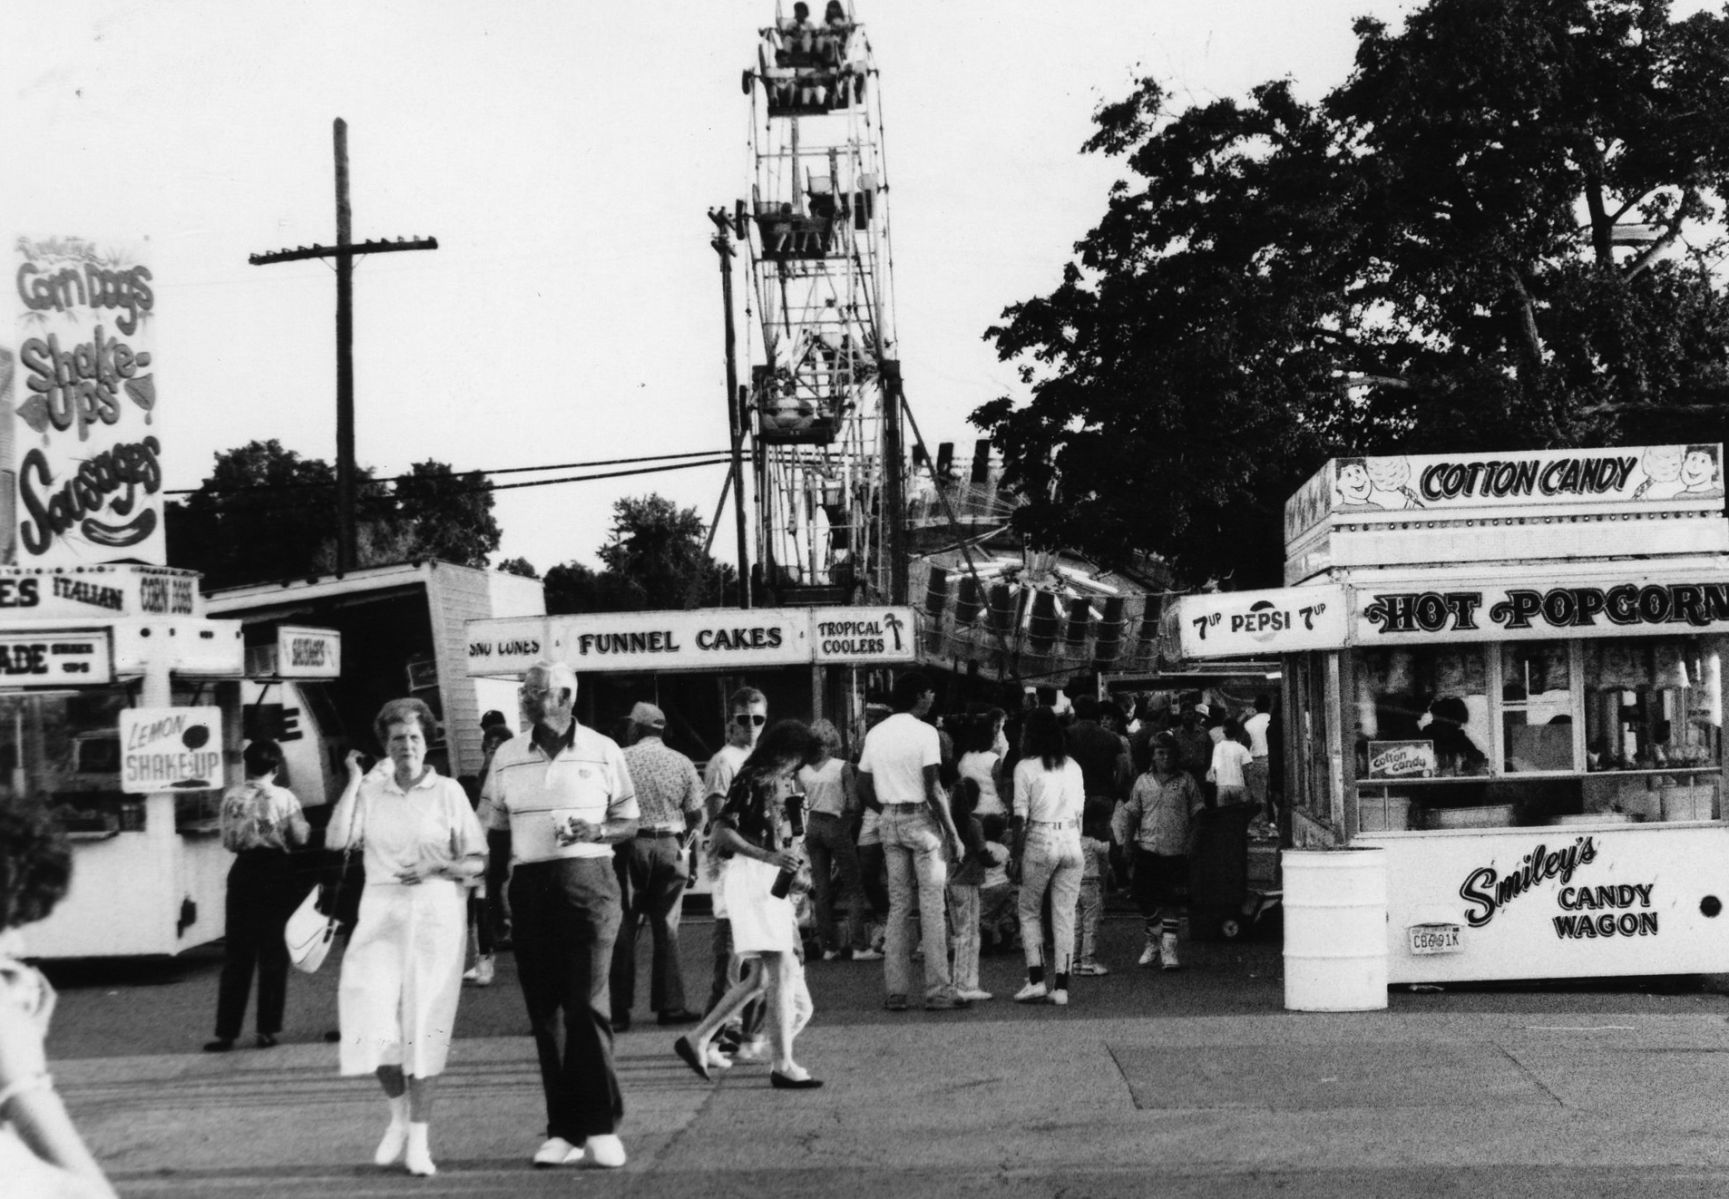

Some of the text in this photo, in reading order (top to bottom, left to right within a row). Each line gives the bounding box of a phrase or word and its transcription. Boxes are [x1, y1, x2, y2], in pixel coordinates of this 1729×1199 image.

[46, 381, 120, 442] Ups
[1420, 456, 1638, 500] COTTON CANDY
[53, 576, 124, 612] ITALIAN
[1364, 582, 1729, 634] HOT POPCORN
[817, 620, 884, 639] TROPICAL
[1231, 611, 1291, 632] PEPSI
[577, 627, 784, 656] FUNNEL CAKES
[822, 638, 885, 655] COOLERS
[127, 714, 187, 752] LEMON
[1459, 836, 1599, 928] Smiley's
[1557, 884, 1653, 911] CANDY
[1552, 911, 1658, 939] WAGON
